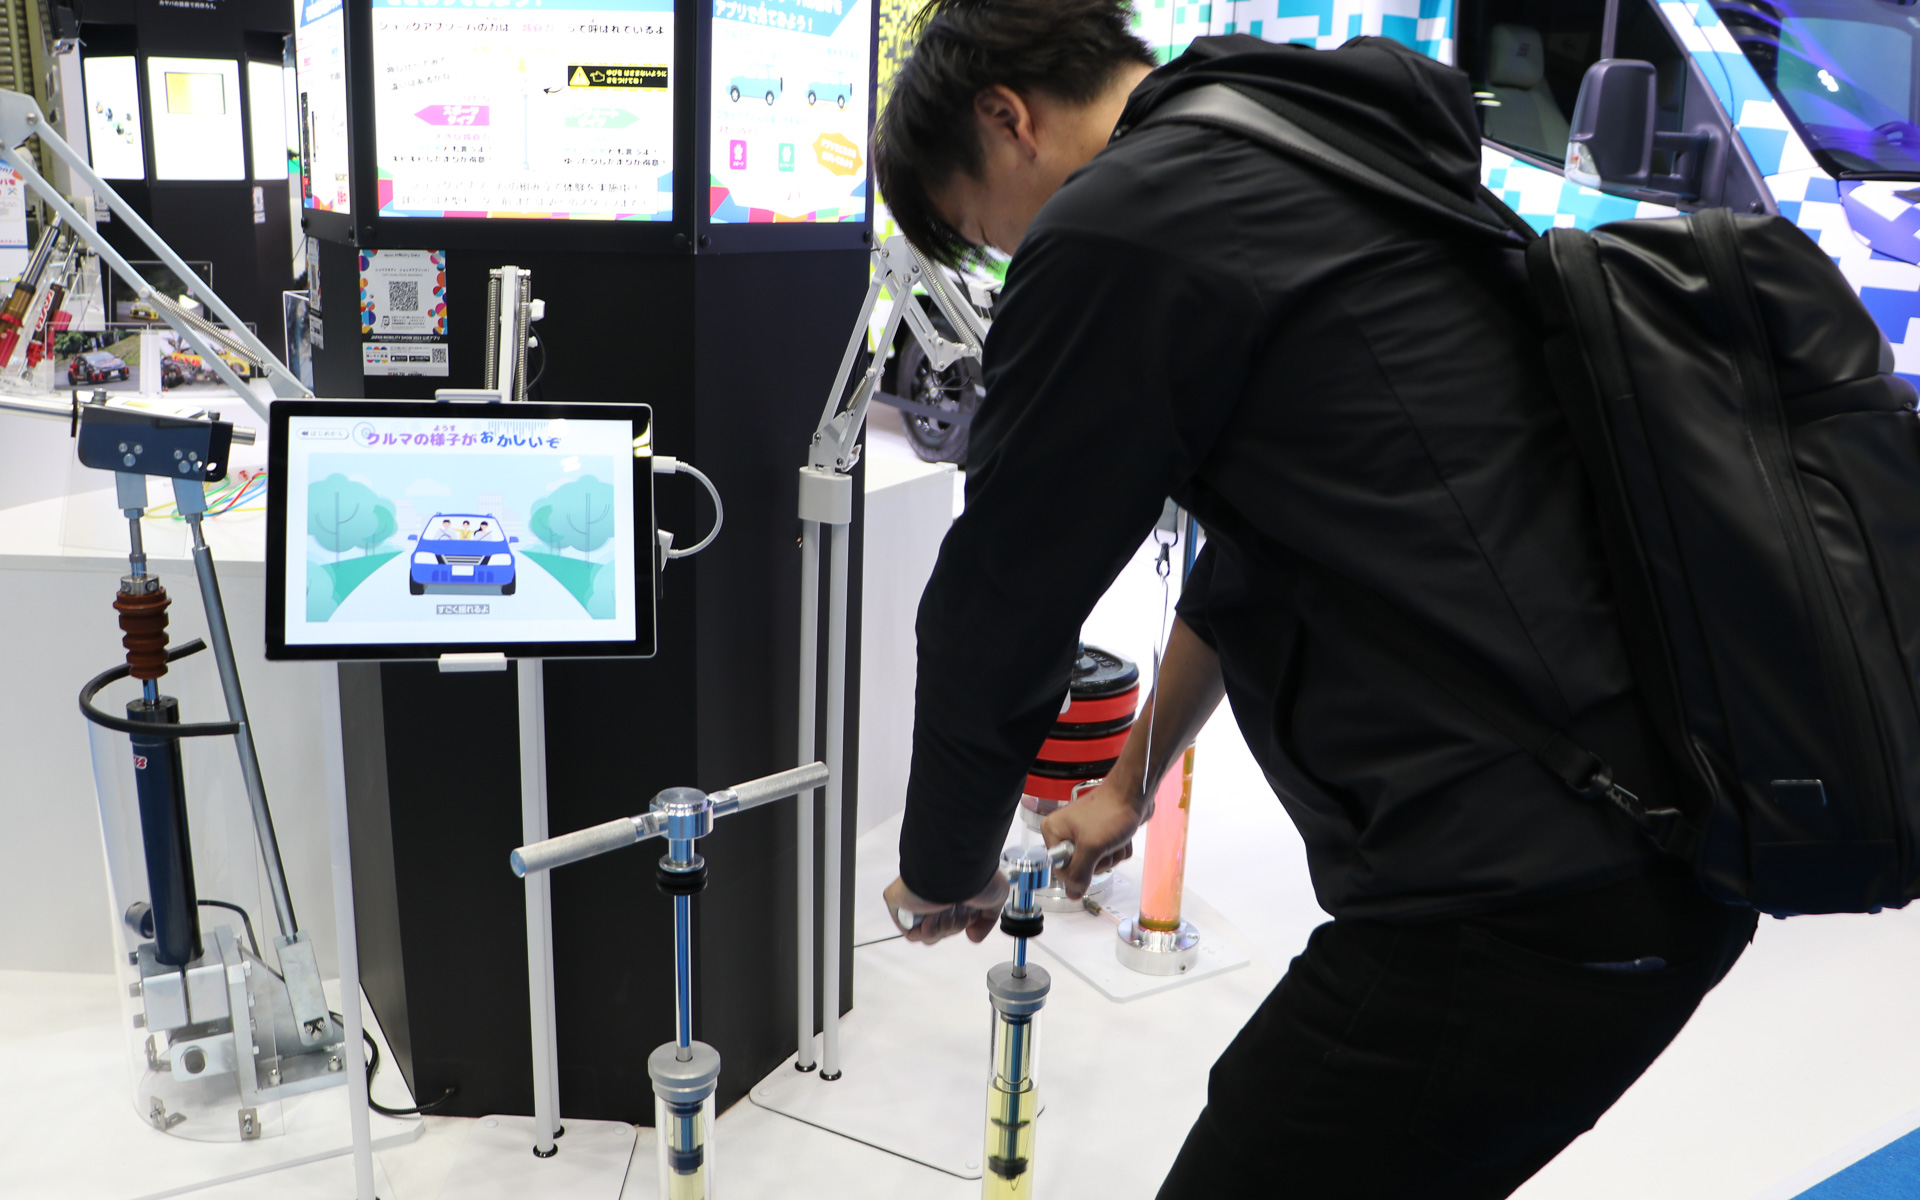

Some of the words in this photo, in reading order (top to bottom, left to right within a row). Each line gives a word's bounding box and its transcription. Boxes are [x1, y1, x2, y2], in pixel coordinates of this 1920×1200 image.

[443, 105, 480, 116] スポーツ
[448, 114, 475, 125] タイプ
[366, 431, 561, 450] クルマの様子がおかしいぞ
